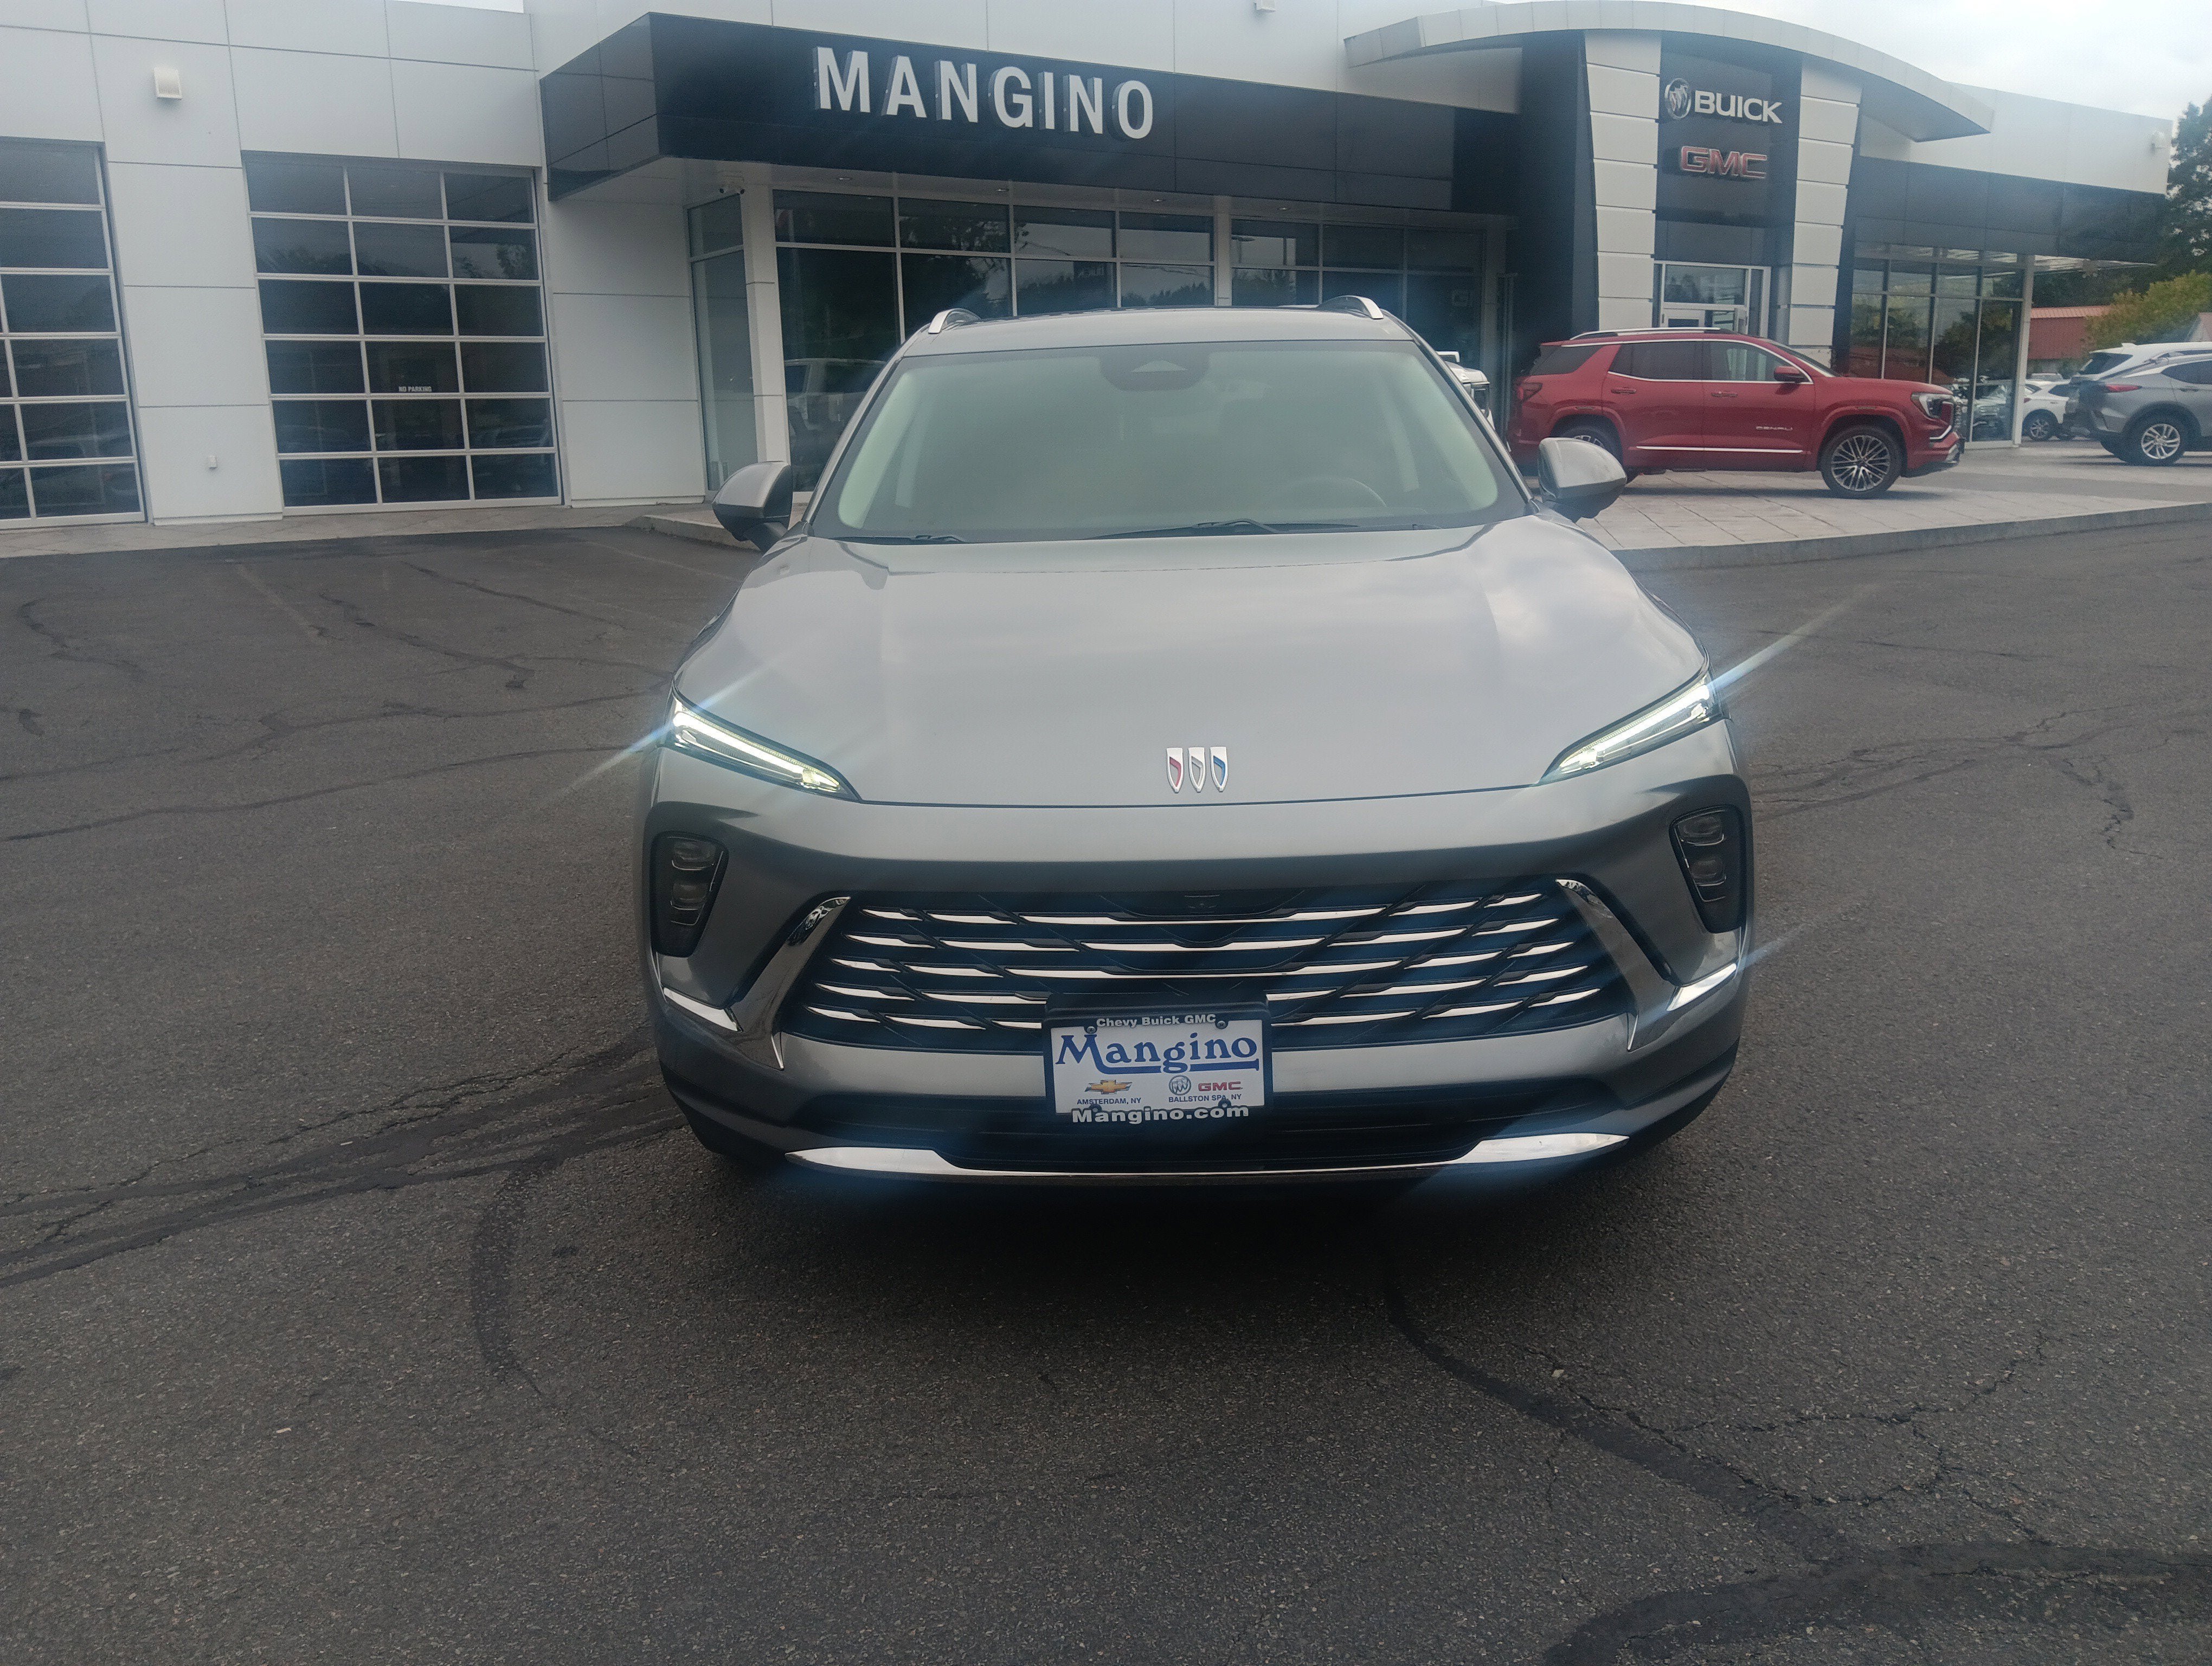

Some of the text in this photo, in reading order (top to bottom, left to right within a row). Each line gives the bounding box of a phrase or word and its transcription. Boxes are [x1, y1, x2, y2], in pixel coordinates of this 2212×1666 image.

[814, 47, 1153, 139] MANGINO
[1694, 90, 1783, 124] BUICK
[1681, 145, 1767, 178] GMC
[1097, 1014, 1216, 1028] Chevy Buick GMC
[1056, 1033, 1259, 1074] Mangino
[1198, 1081, 1243, 1092] GMC
[1072, 1106, 1249, 1124] Mangino.com
